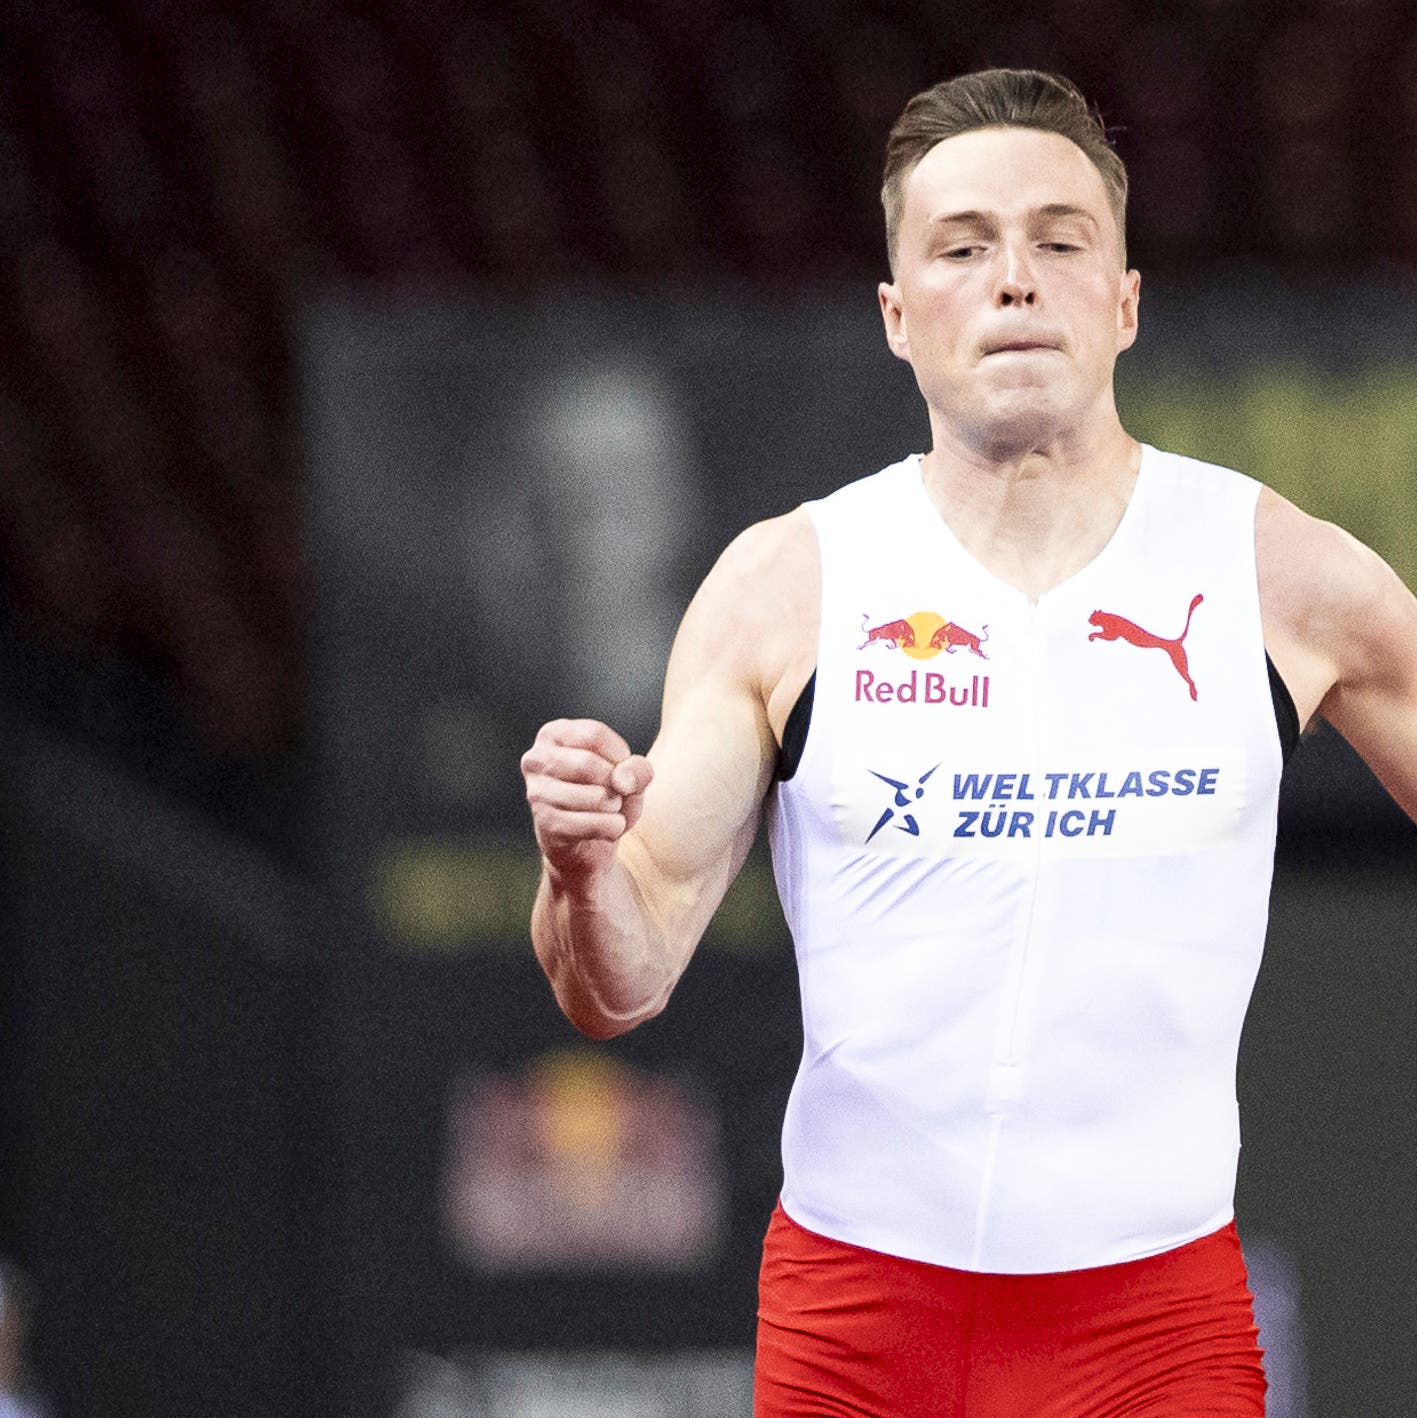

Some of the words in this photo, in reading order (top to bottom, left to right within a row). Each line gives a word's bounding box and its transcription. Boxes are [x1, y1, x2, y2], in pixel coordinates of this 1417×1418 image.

[855, 669, 917, 703] Red
[925, 672, 989, 707] Bull
[952, 768, 1220, 800] WELTKLASSE
[953, 803, 1117, 838] ZÜRICH
